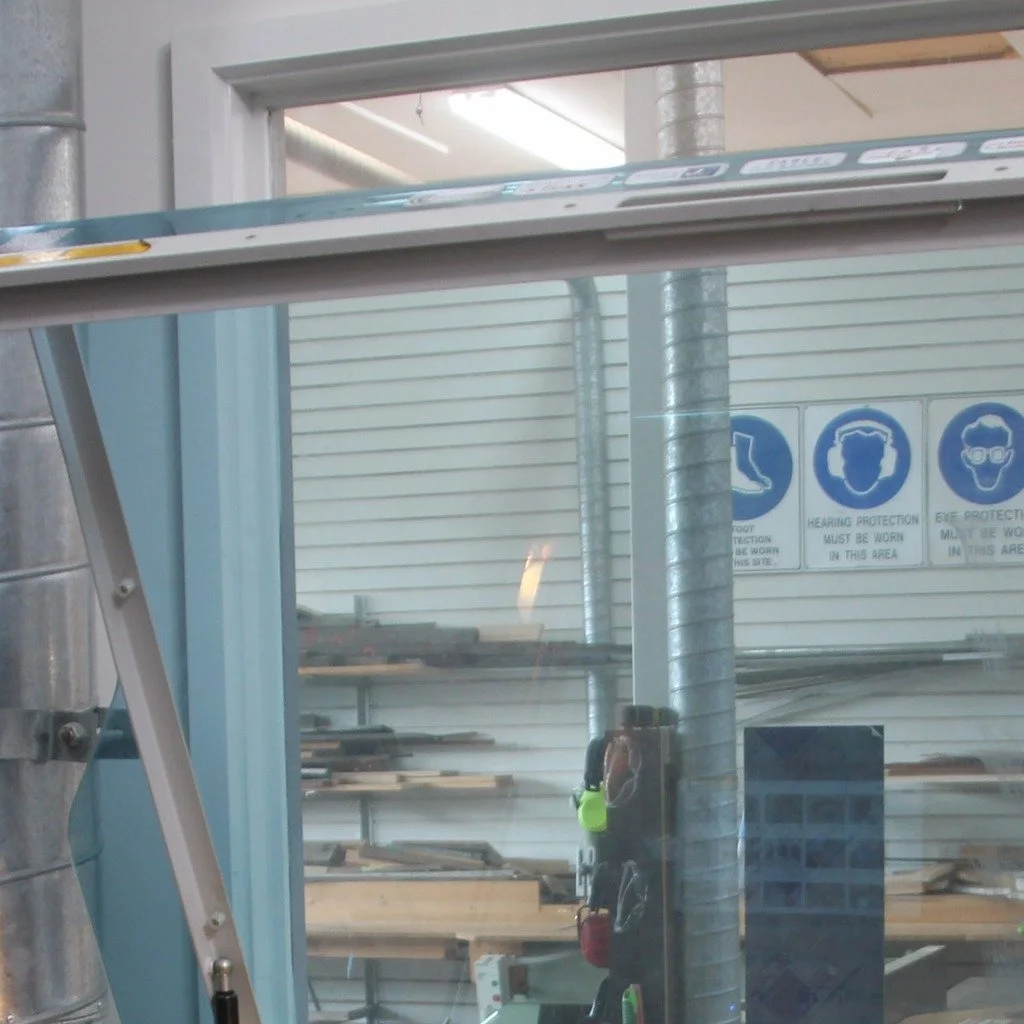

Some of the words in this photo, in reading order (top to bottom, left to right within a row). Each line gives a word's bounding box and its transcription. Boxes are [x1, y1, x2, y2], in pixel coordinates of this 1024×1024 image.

[806, 516, 852, 528] HEARING
[856, 513, 919, 527] PROTECTION
[935, 511, 957, 523] EYE
[964, 509, 1024, 521] PROTECTI
[823, 533, 850, 545] MUST
[855, 533, 869, 544] BE
[874, 532, 904, 543] WORN
[940, 528, 973, 540] MUT
[980, 527, 996, 538] BE
[1003, 526, 1024, 538] WO
[733, 535, 772, 545] TECTION
[829, 550, 840, 561] IN
[845, 549, 867, 560] THIS
[871, 548, 899, 559] AREA
[948, 545, 960, 557] IN
[968, 545, 994, 556] THIS
[1000, 543, 1024, 555] ARE
[733, 557, 749, 567] HIS
